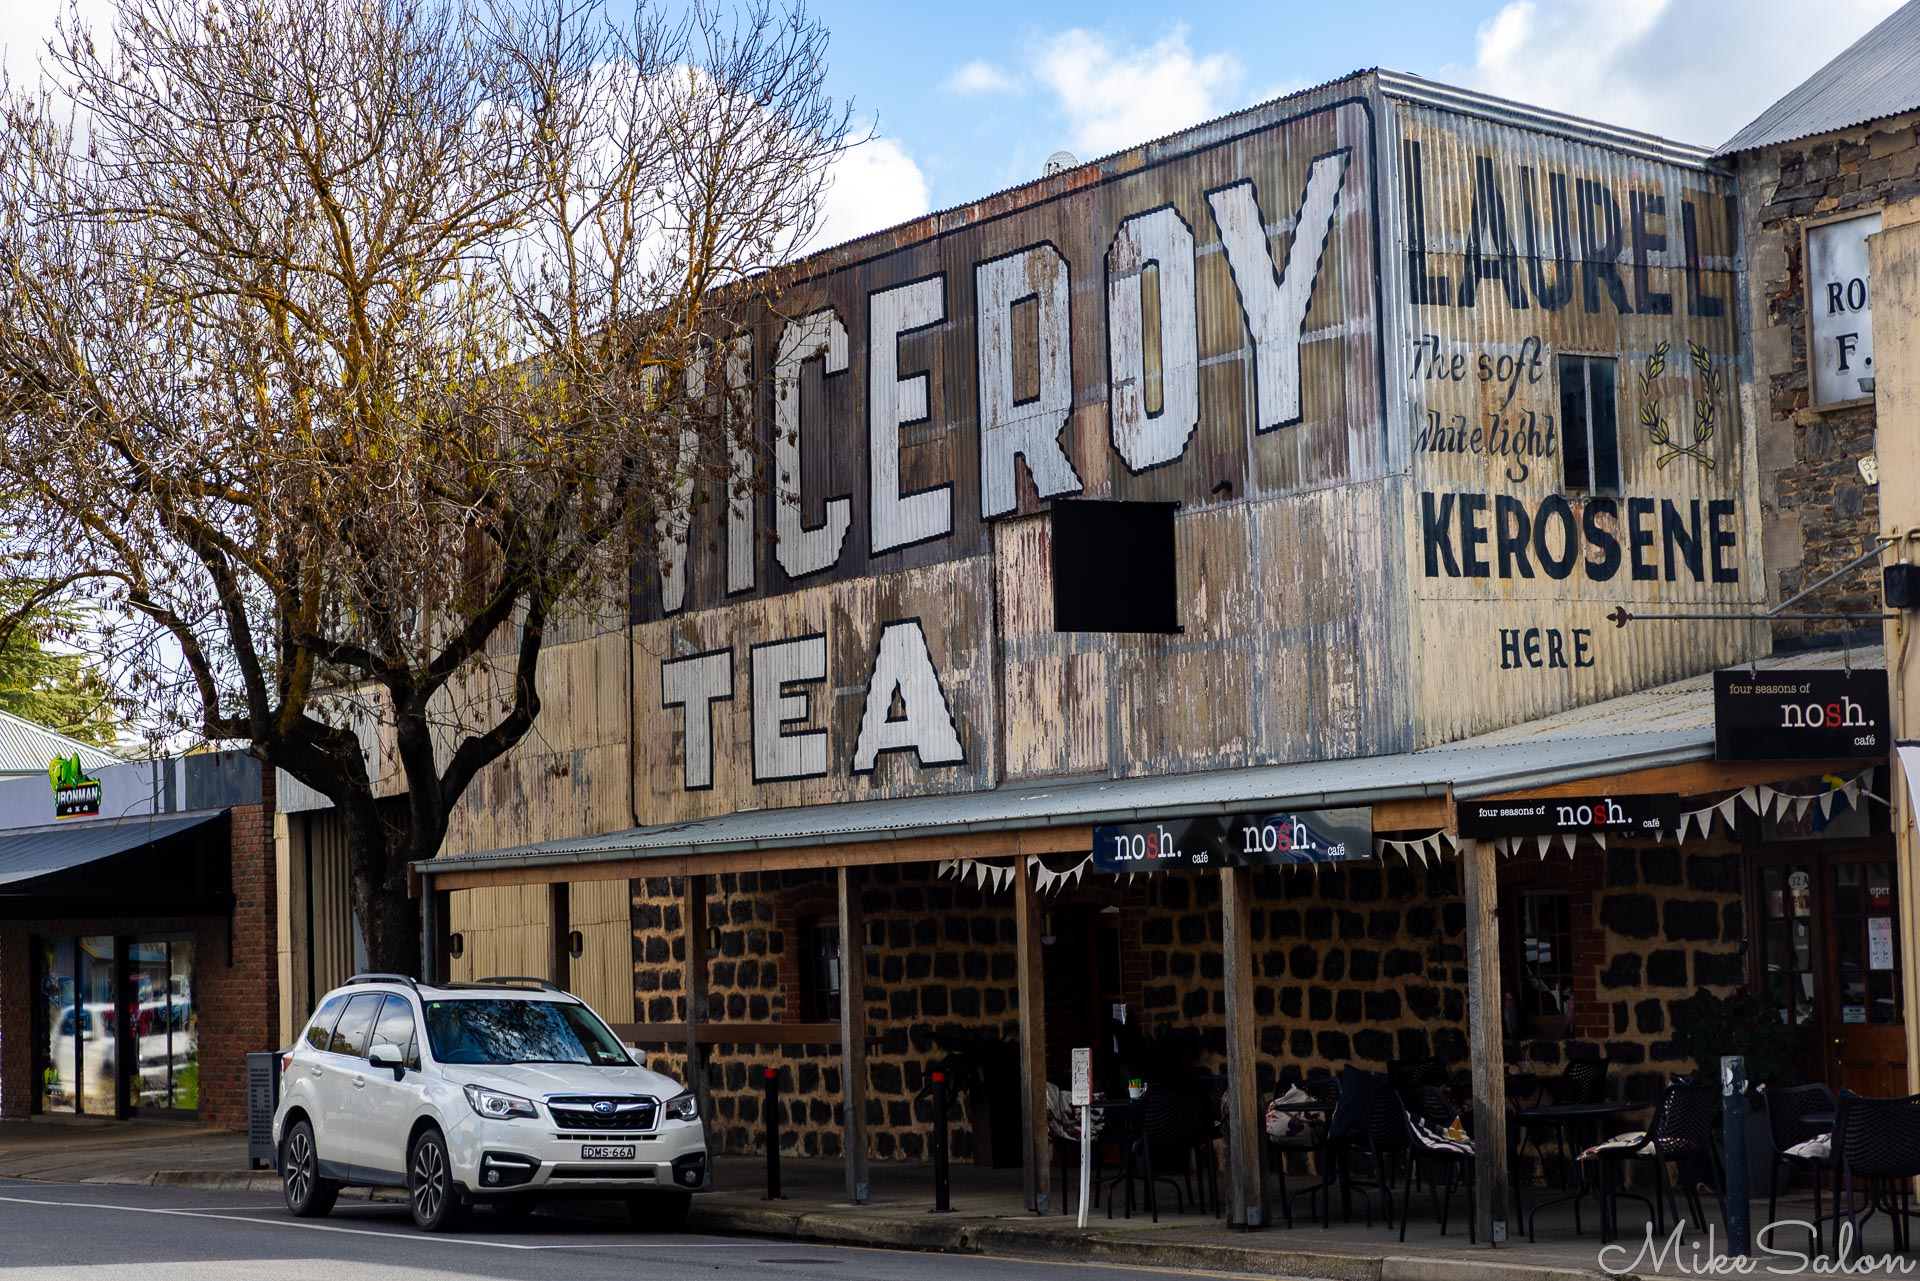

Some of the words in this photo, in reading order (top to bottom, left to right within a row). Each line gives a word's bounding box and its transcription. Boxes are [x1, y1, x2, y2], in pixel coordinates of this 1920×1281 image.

[1403, 138, 1724, 317] LAUREL
[1827, 277, 1872, 317] RO
[1409, 334, 1466, 381] The
[1478, 335, 1543, 410] soft
[1488, 408, 1557, 483] light
[1421, 492, 1738, 582] KEROSENE
[1499, 628, 1594, 669] HERE
[661, 616, 967, 791] TEA
[1729, 683, 1752, 694] four
[1755, 684, 1797, 694] seasons
[1799, 683, 1811, 694] of
[1781, 696, 1875, 728] nosh.
[1854, 734, 1876, 746] café
[57, 786, 98, 805] IRONMAN
[1478, 808, 1498, 817] four
[1500, 808, 1534, 817] seasons
[1536, 806, 1545, 815] of
[1556, 799, 1633, 826] nosh.
[1243, 815, 1317, 853] nosh.
[1327, 842, 1345, 857] café
[1643, 818, 1660, 828] café
[1114, 825, 1182, 861] nosh.
[1192, 852, 1209, 865] café
